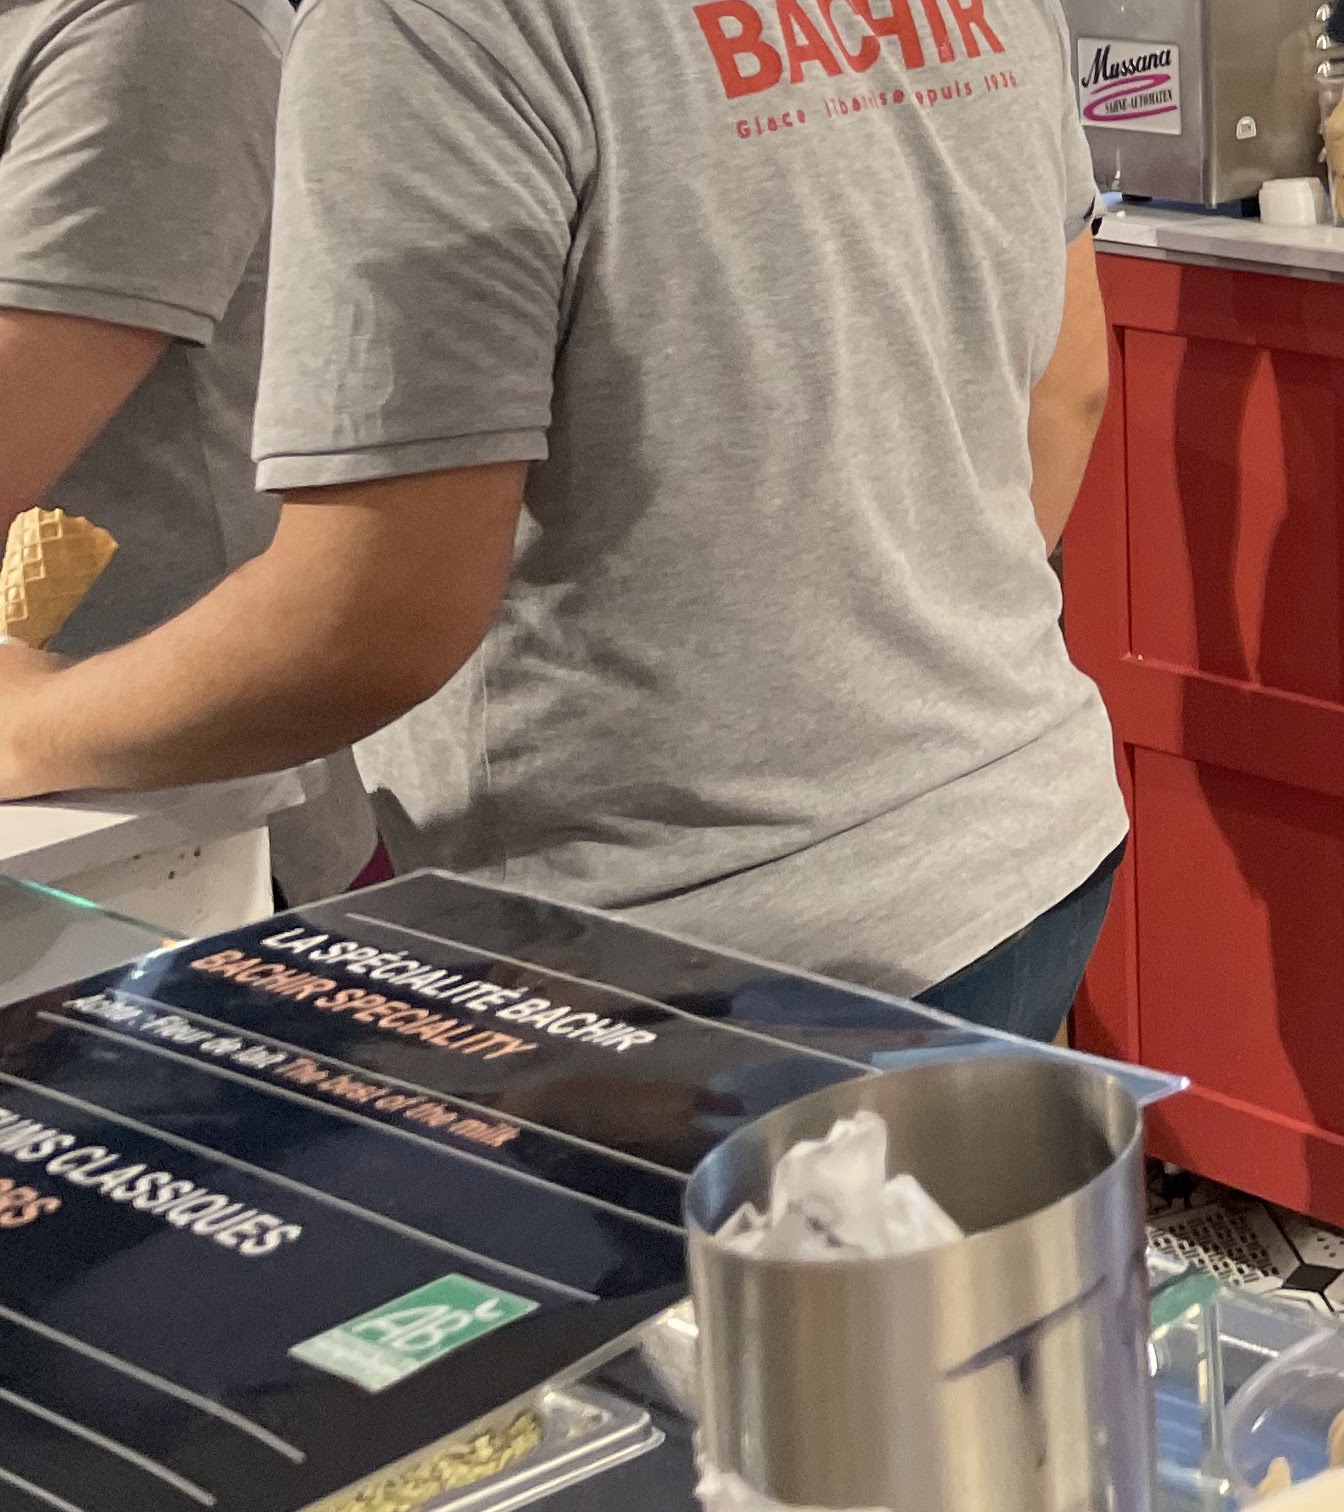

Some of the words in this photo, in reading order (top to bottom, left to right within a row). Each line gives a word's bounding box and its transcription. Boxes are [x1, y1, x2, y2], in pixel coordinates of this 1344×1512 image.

[736, 108, 806, 139] Glace
[984, 71, 1017, 92] 1936
[1081, 45, 1171, 88] Mussana
[189, 949, 337, 1003] BACHIR
[314, 988, 540, 1060] SPECIALITY
[260, 927, 330, 954] LA
[309, 940, 528, 1012] SPÉCIALITÉ
[495, 993, 658, 1053] BACHIR
[45, 1145, 303, 1258] CLASSIQUES
